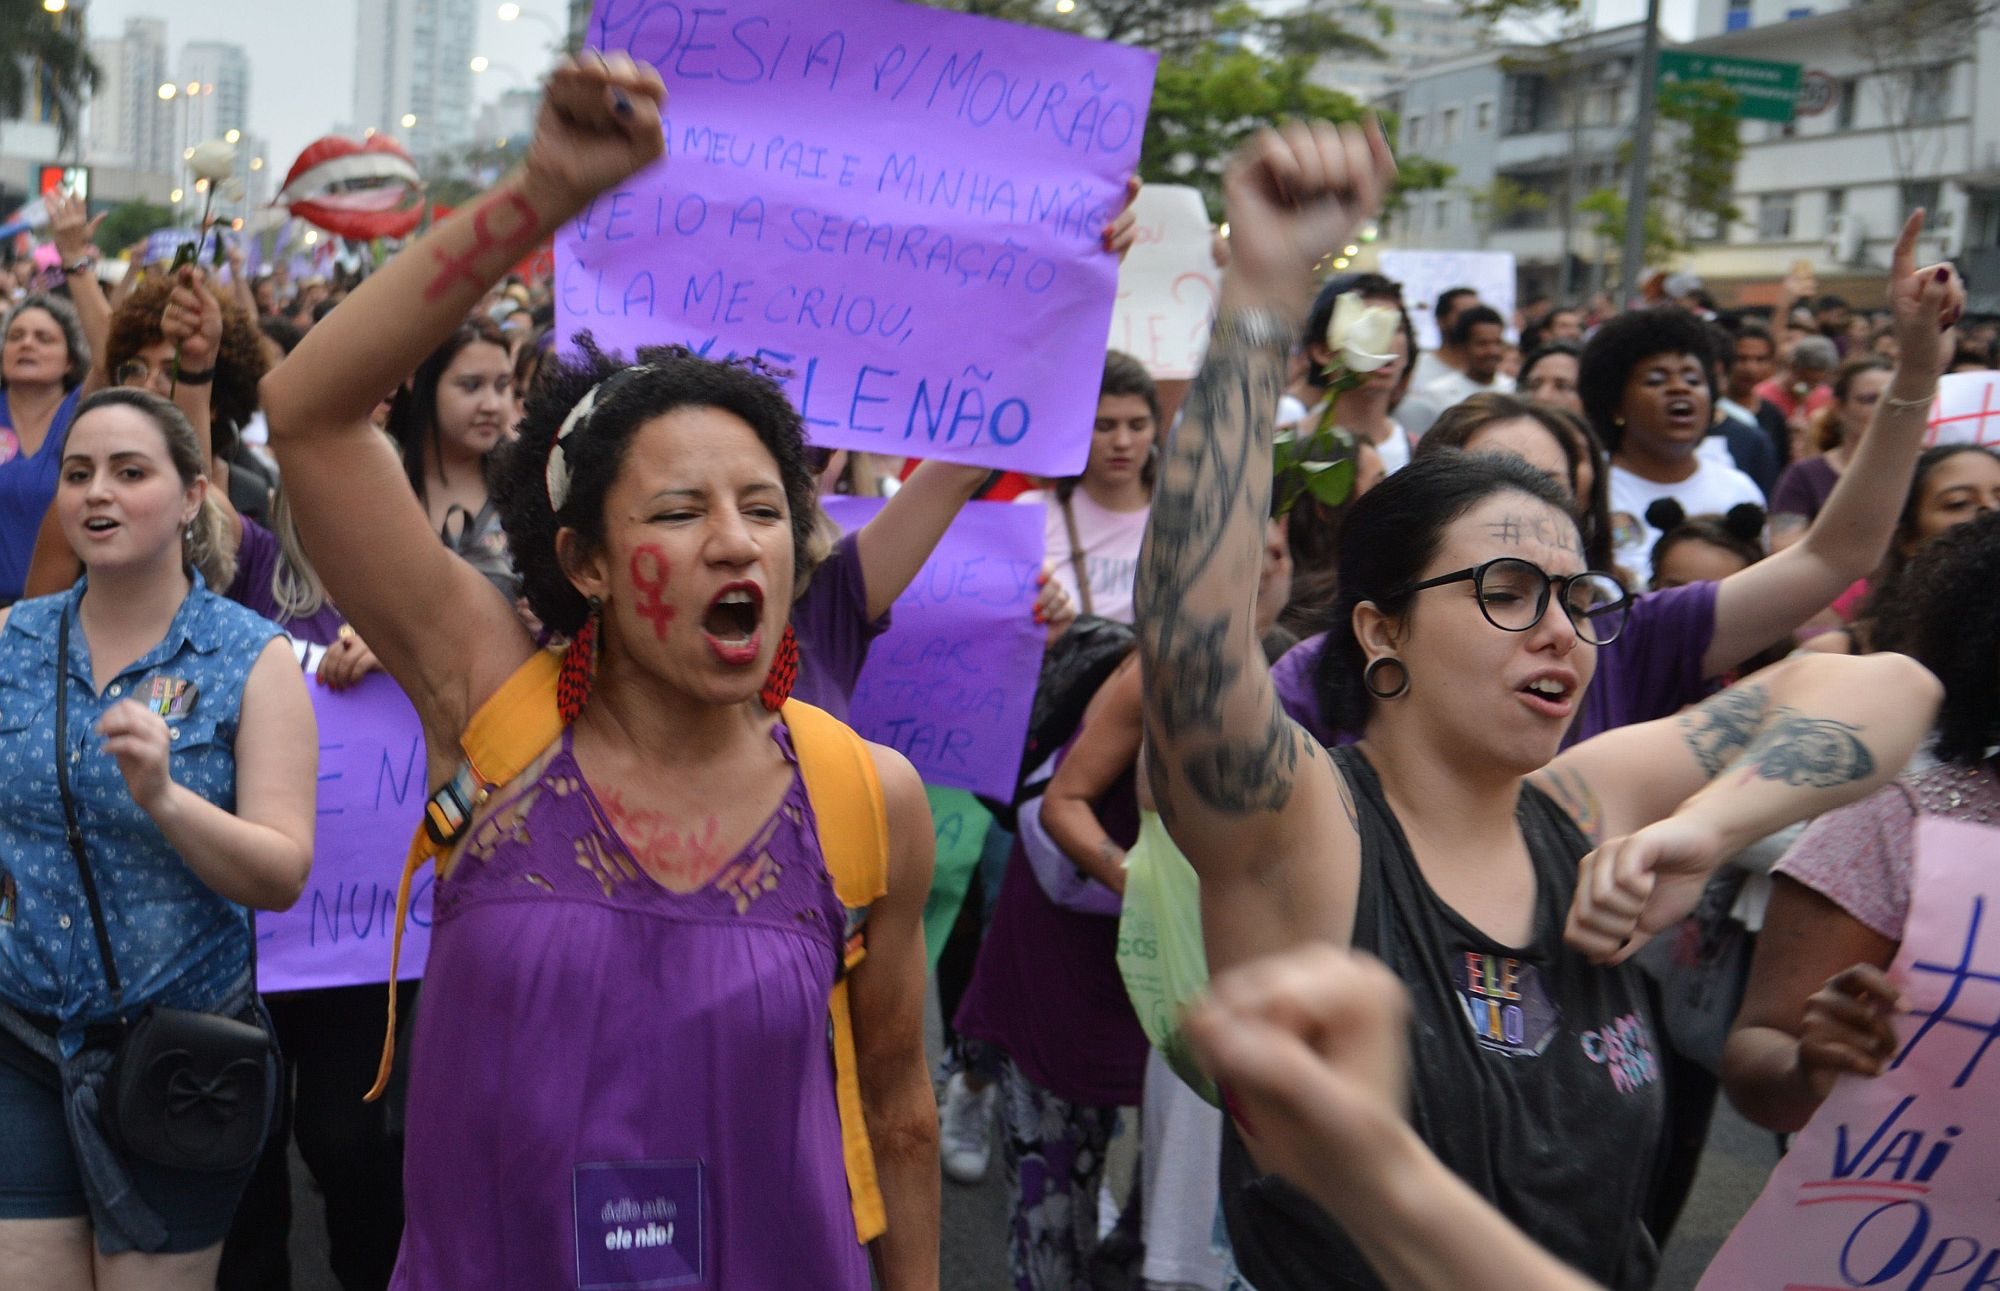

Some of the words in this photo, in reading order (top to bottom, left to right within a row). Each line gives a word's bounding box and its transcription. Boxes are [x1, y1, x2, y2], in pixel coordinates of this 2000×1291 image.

[599, 0, 846, 92] POESIA
[926, 48, 1136, 153] MOURÃO
[878, 152, 1018, 222] MINHA
[575, 191, 707, 241] VEIO
[729, 195, 765, 242] A
[783, 206, 1057, 294] SEPARAÇÃO
[562, 257, 655, 318] ELA
[683, 267, 756, 324] ME
[1464, 951, 1521, 1000] ELE
